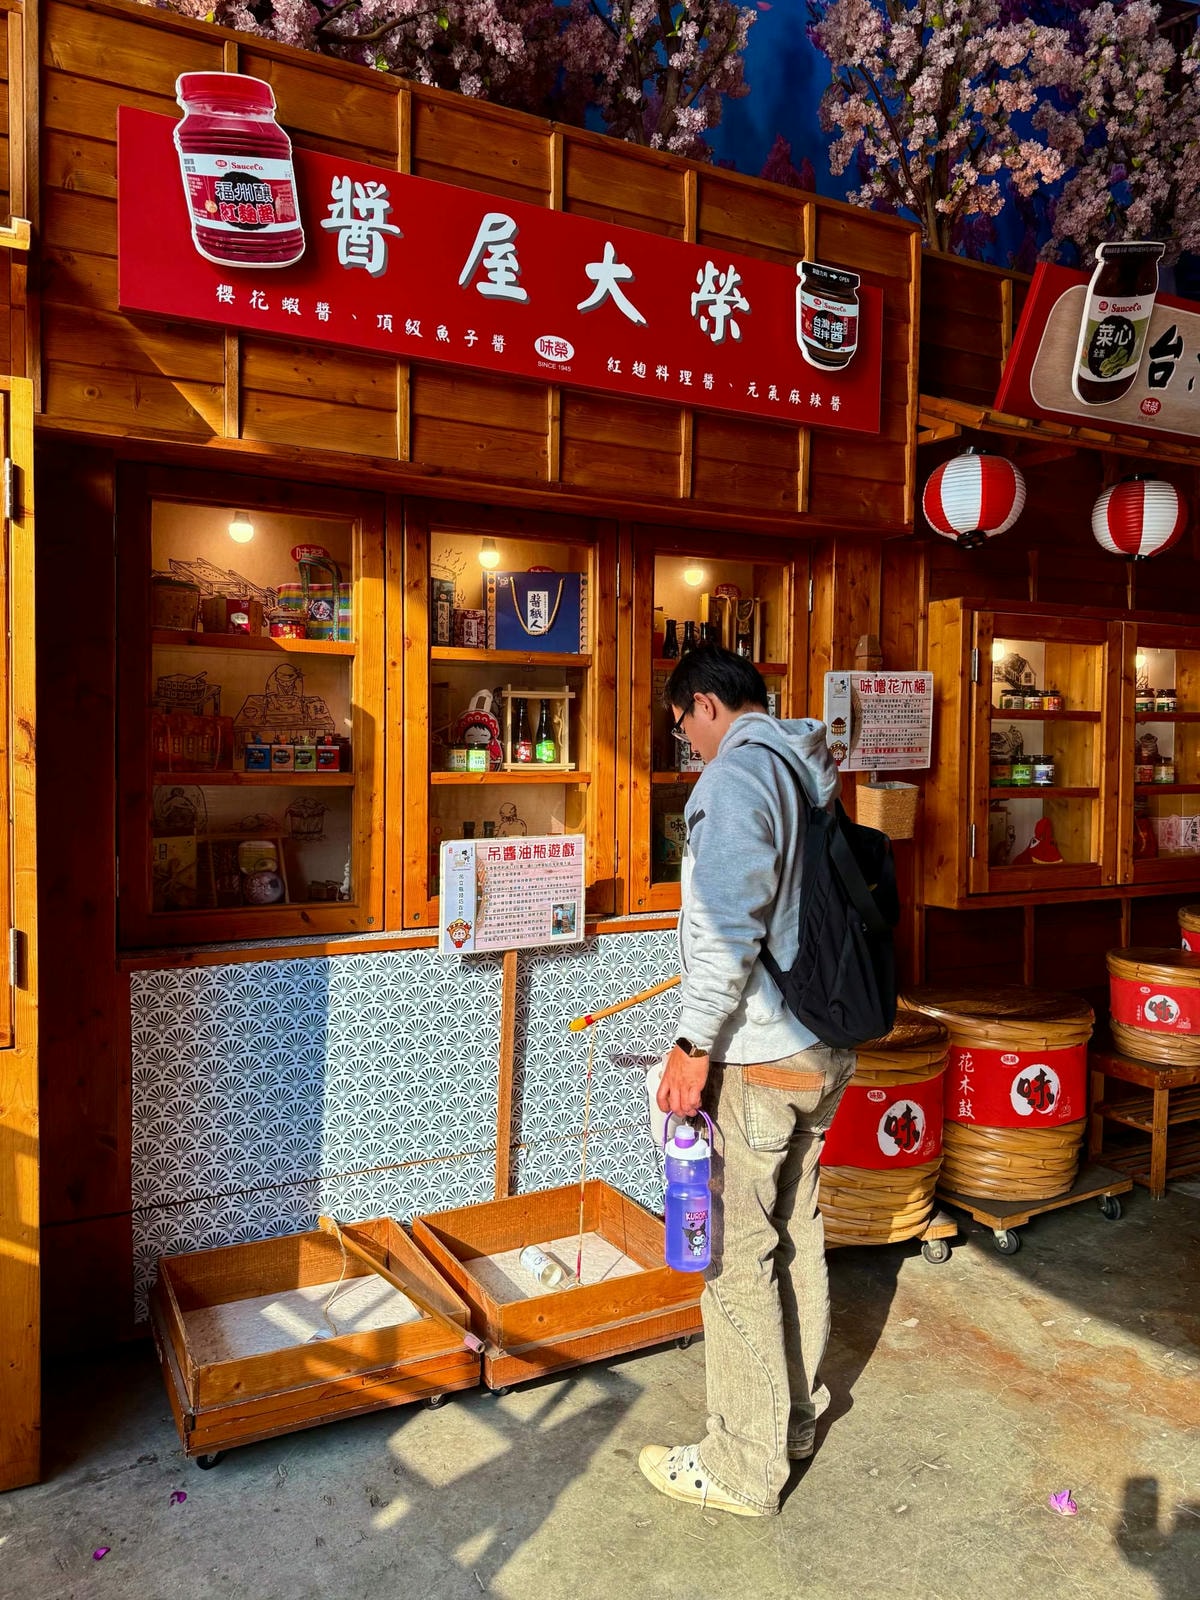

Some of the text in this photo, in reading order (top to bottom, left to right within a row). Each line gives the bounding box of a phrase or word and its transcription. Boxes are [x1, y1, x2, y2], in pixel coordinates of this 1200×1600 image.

[215, 181, 273, 203] 福州釀
[1096, 324, 1132, 347] 菜心
[540, 339, 568, 358] 味榮
[538, 361, 572, 372] SINCE 1945
[529, 593, 543, 629] 醬職人
[860, 678, 926, 694] 味噌花木桶
[488, 843, 575, 861] 吊醬油瓶遊戲
[957, 1052, 975, 1119] 花木鼓
[1017, 1067, 1055, 1109] 味
[883, 1103, 921, 1149] 味
